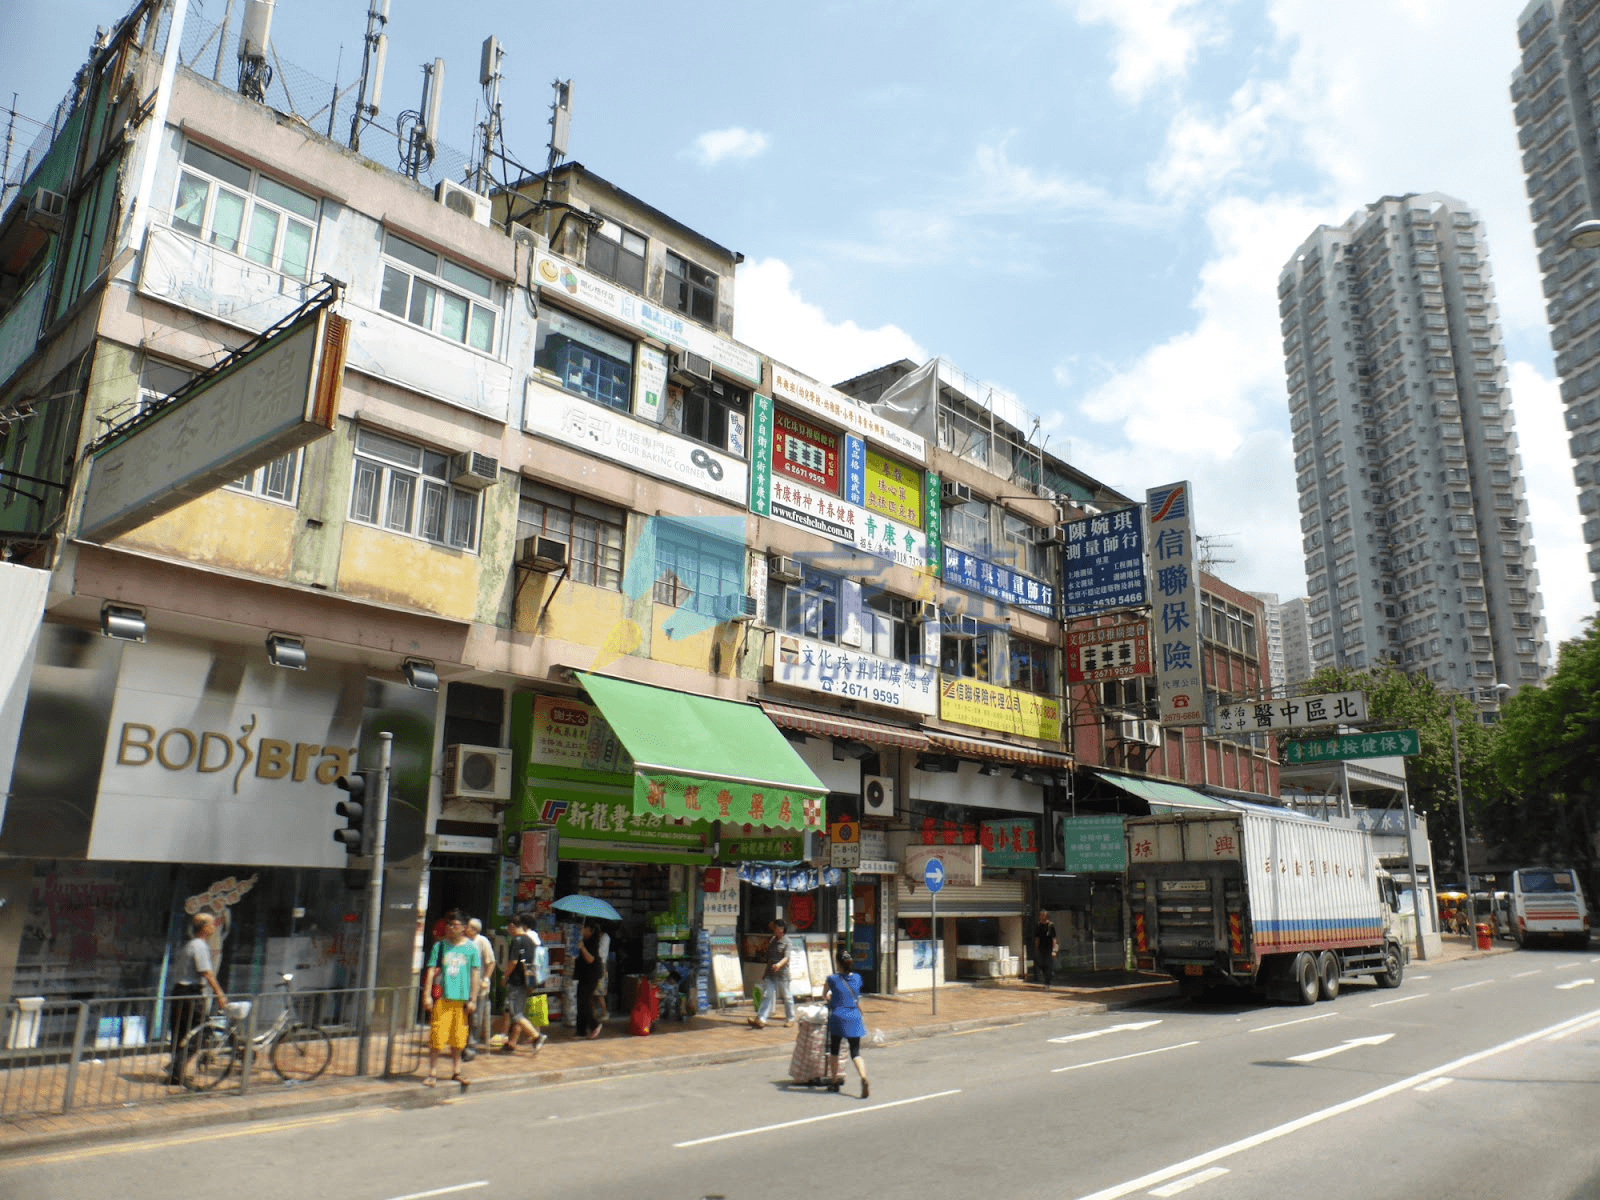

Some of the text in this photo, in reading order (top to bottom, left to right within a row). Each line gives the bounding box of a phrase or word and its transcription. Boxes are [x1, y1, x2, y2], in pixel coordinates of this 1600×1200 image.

[616, 426, 677, 459] 烘焙專門店
[616, 440, 706, 481] YOUR BAKING CORNER
[791, 464, 826, 485] 2671 9595
[773, 481, 856, 526] 青康精神 青春健康
[772, 504, 854, 540] www.freshclub.com.hk
[864, 515, 917, 554] 青康會
[1068, 511, 1133, 542] 陳婉琪
[1066, 531, 1138, 560] 測量師行
[945, 546, 1053, 605] 陳婉琪測量師行
[1118, 593, 1142, 604] 5466
[1154, 528, 1193, 673] 信聯保險
[1069, 624, 1145, 646] 文化珠算推廣總會
[802, 643, 932, 694] 文化珠算推廣總會
[1094, 666, 1134, 679] 2671 9595
[1162, 677, 1199, 690] 代理公司
[842, 680, 900, 705] 2671 9595
[956, 682, 1021, 713] 信聯保險代理公司
